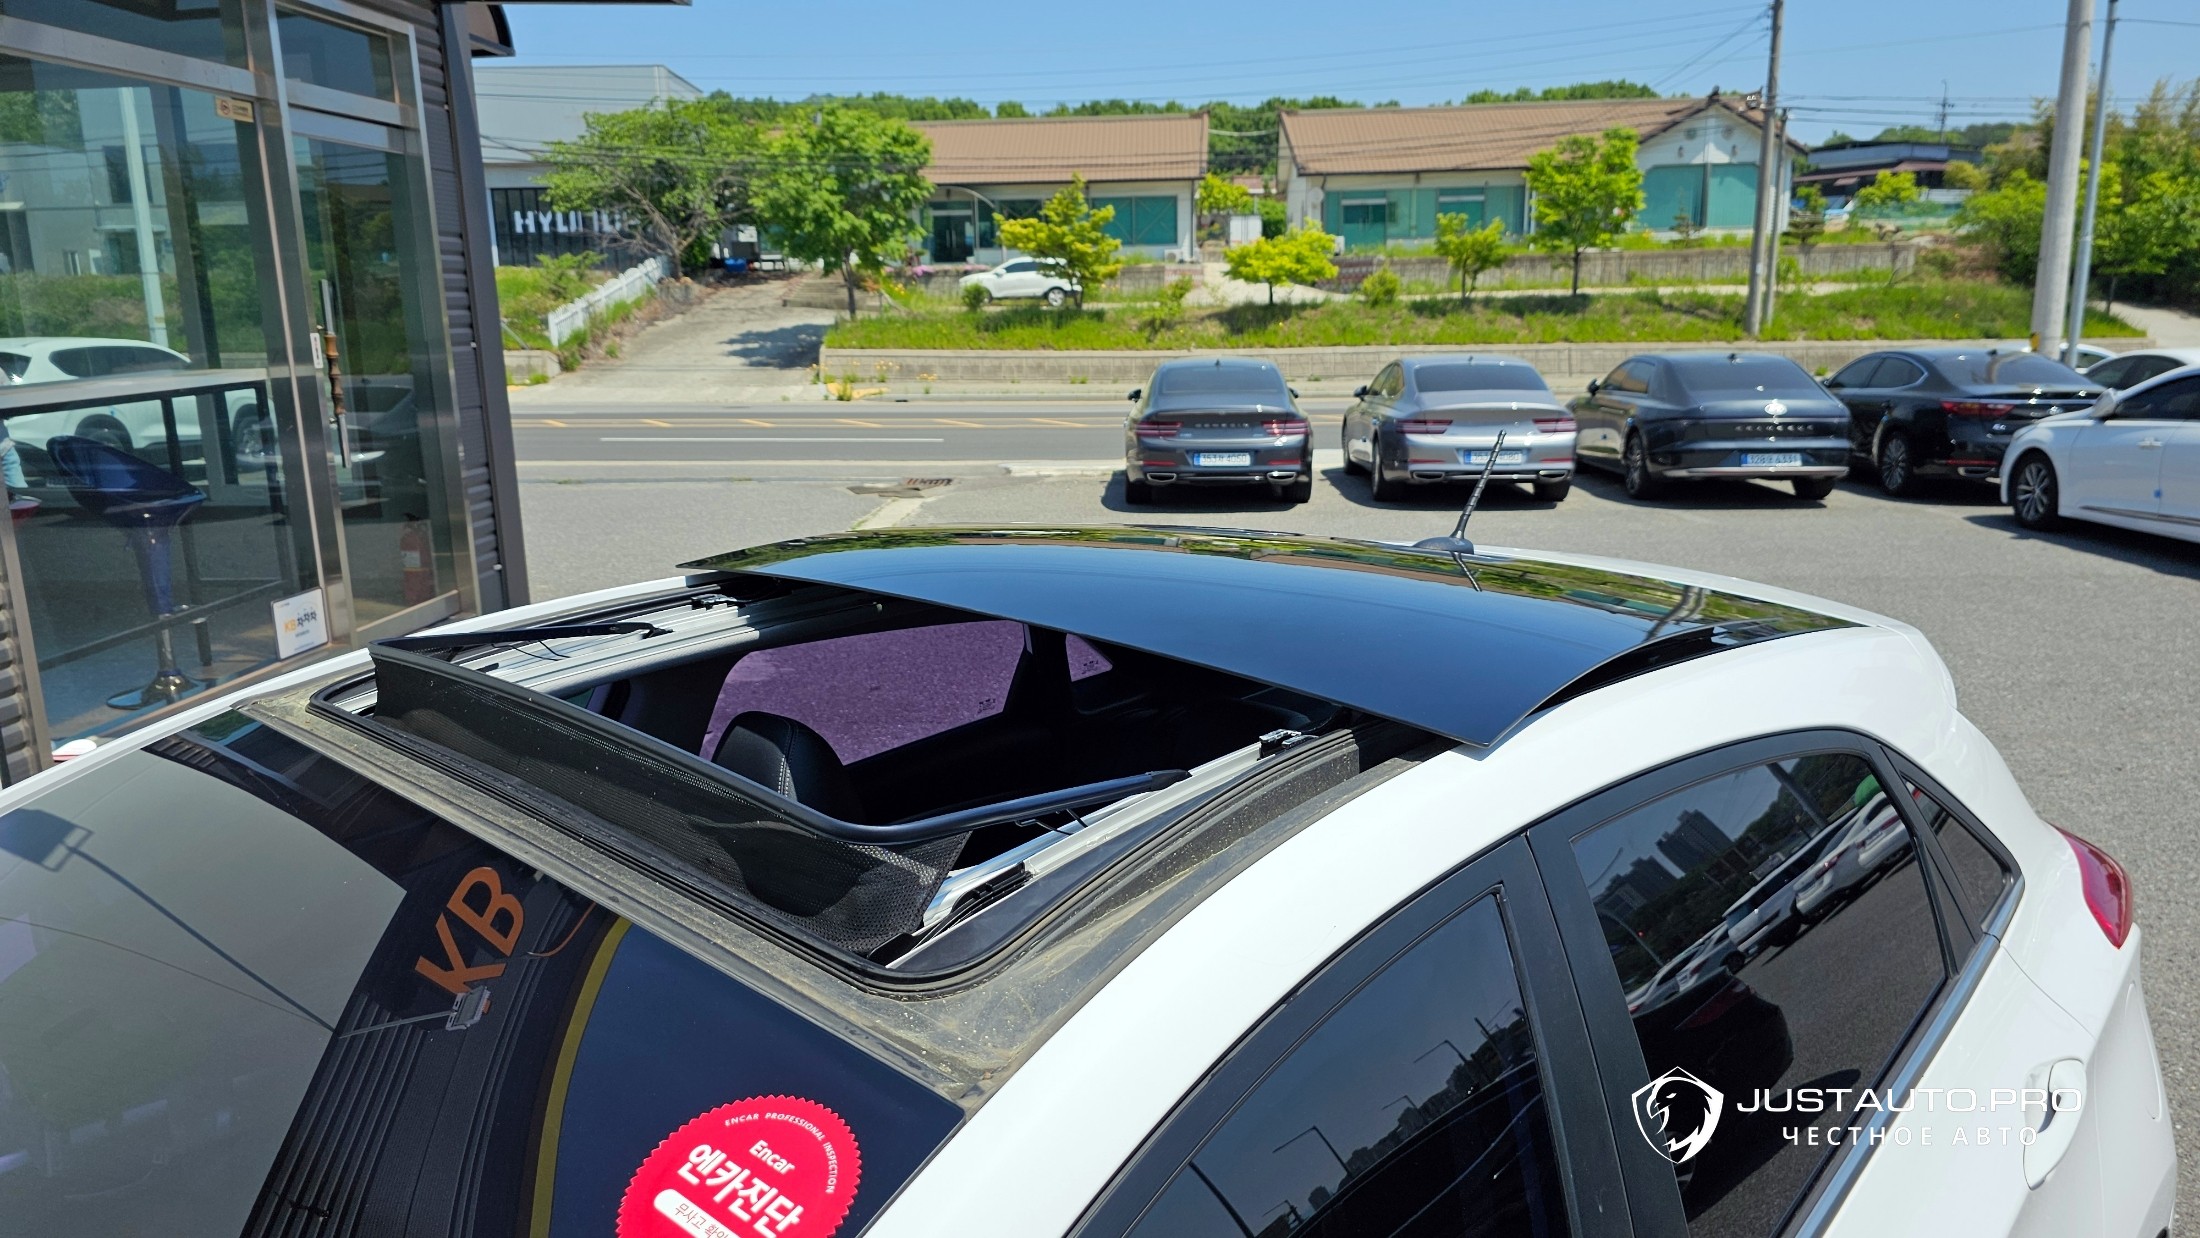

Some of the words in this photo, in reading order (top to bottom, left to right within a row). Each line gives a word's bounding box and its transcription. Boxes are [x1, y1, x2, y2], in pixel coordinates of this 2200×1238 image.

[725, 1113, 759, 1127] ENCAR
[764, 1112, 825, 1141] PROFESSIONAL
[822, 1142, 838, 1194] INSPECTION
[749, 1139, 796, 1175] Encar
[675, 1203, 707, 1230] 무사고
[677, 1144, 804, 1238] 엔카진단
